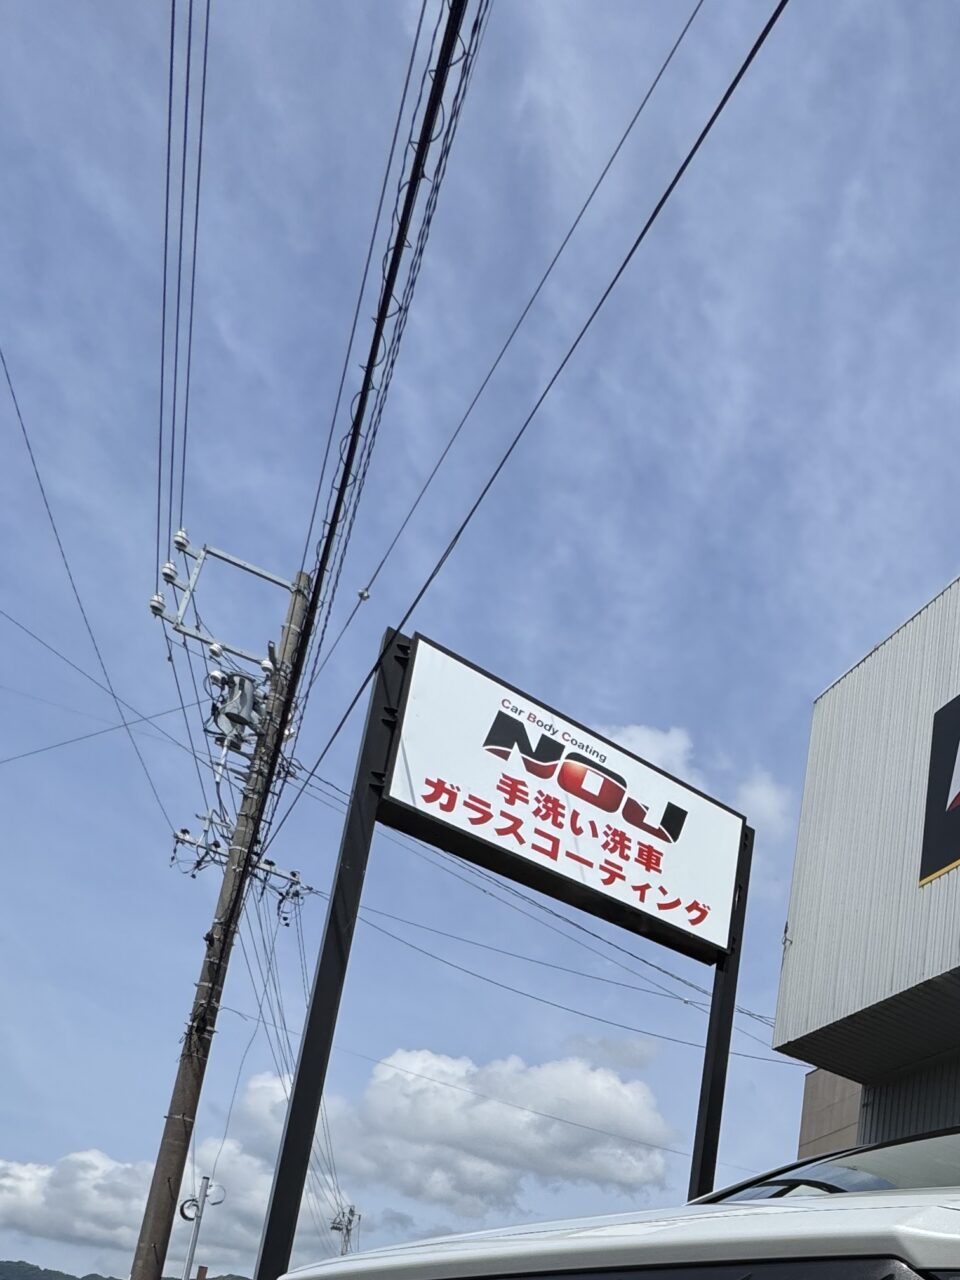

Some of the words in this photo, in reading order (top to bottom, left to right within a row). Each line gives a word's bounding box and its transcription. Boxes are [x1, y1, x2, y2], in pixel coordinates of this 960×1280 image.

[482, 709, 688, 844] NOJ
[501, 699, 525, 716] Car
[527, 712, 559, 736] Body
[561, 732, 607, 763] Coating
[421, 776, 711, 926] ガラスコーティング
[496, 773, 664, 874] 手洗い洗車
